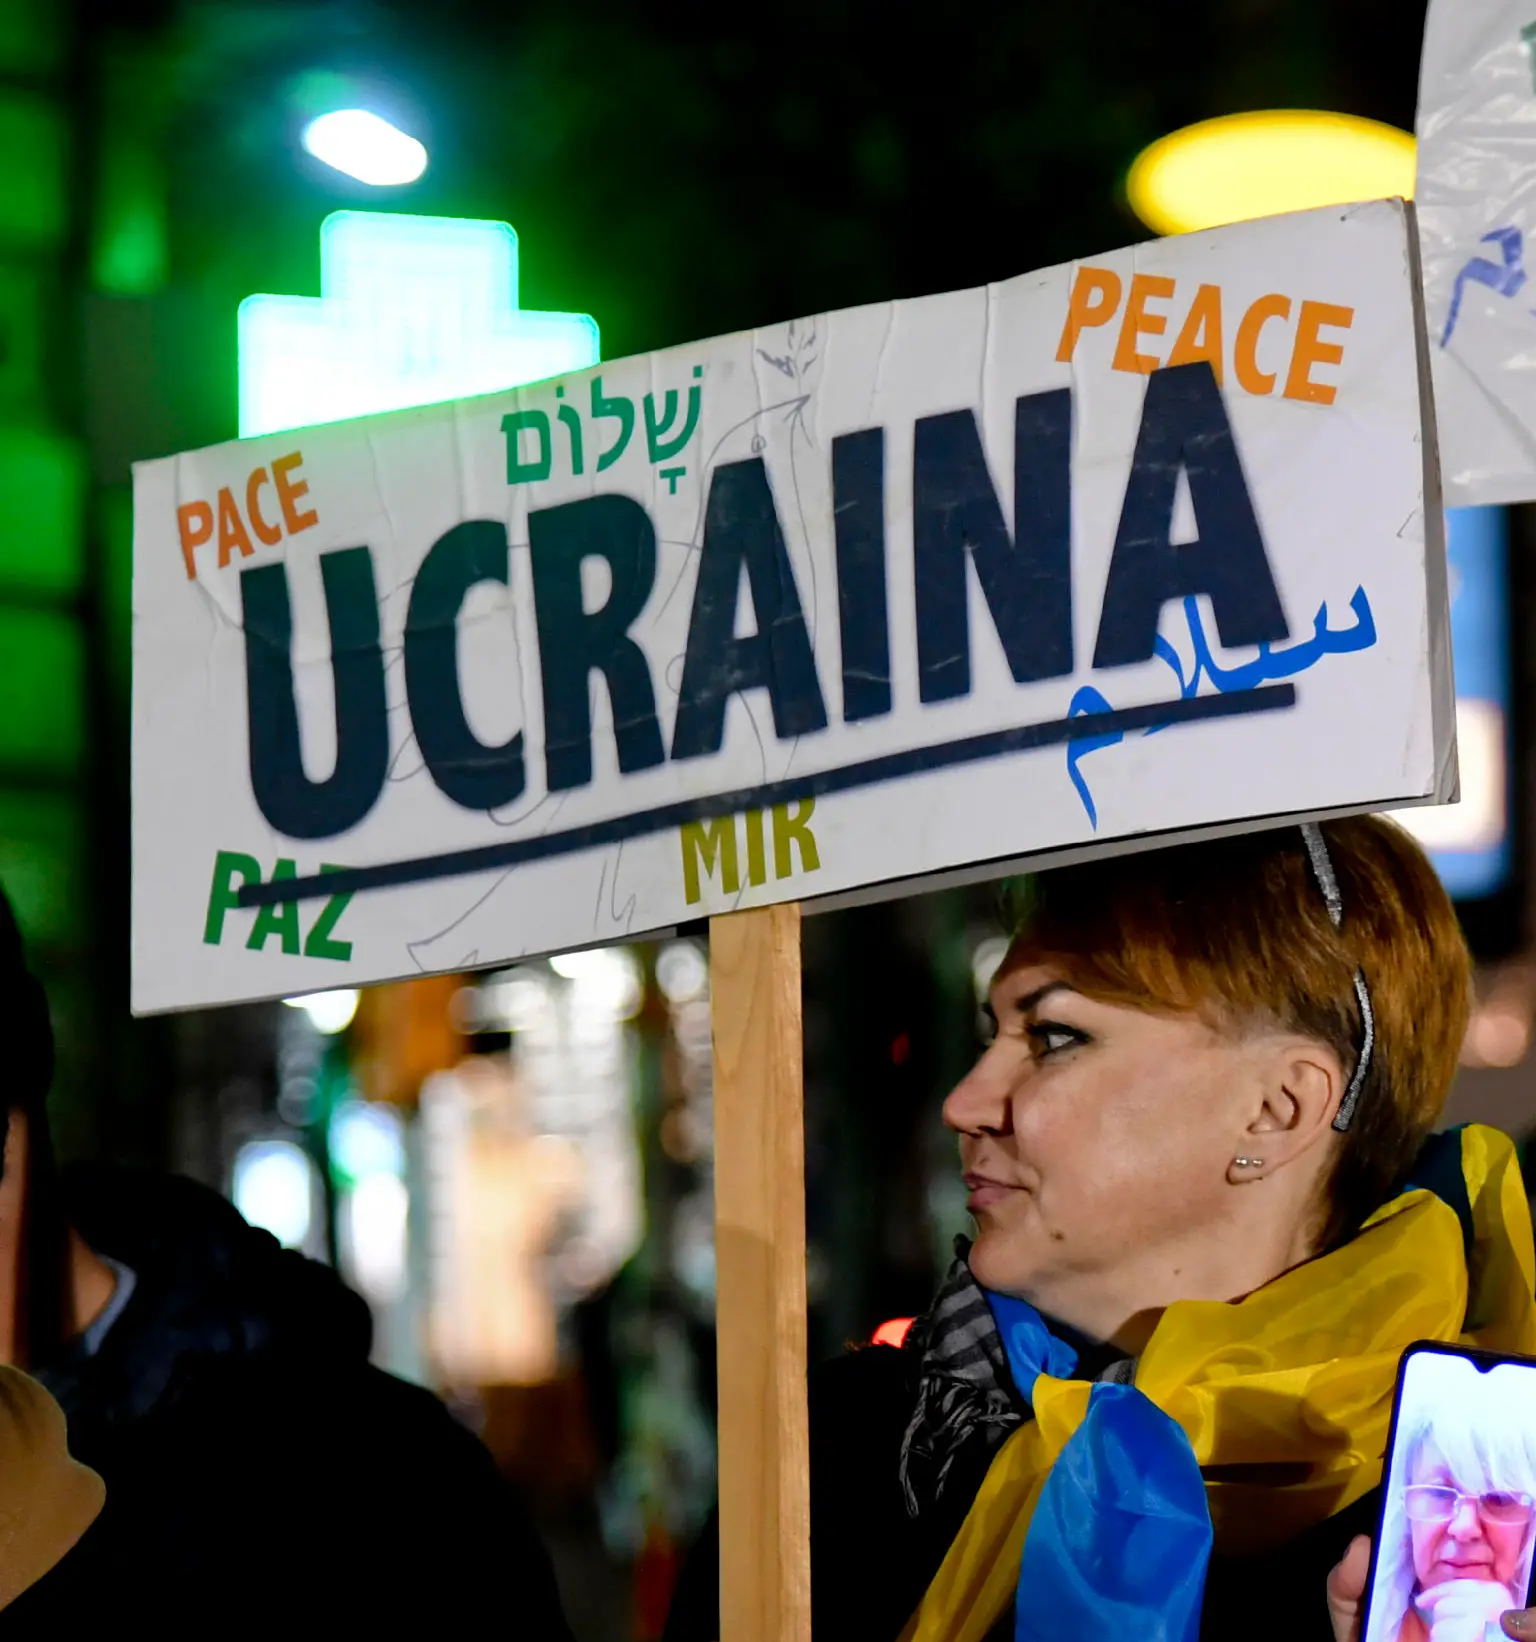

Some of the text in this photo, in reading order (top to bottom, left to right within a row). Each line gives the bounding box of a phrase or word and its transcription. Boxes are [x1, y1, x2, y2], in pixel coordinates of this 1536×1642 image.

[1055, 265, 1354, 406] PEACE
[176, 451, 319, 580] PACE
[239, 360, 1291, 841] UCRAINA
[203, 849, 358, 963] PAZ
[680, 796, 821, 905] MIR
